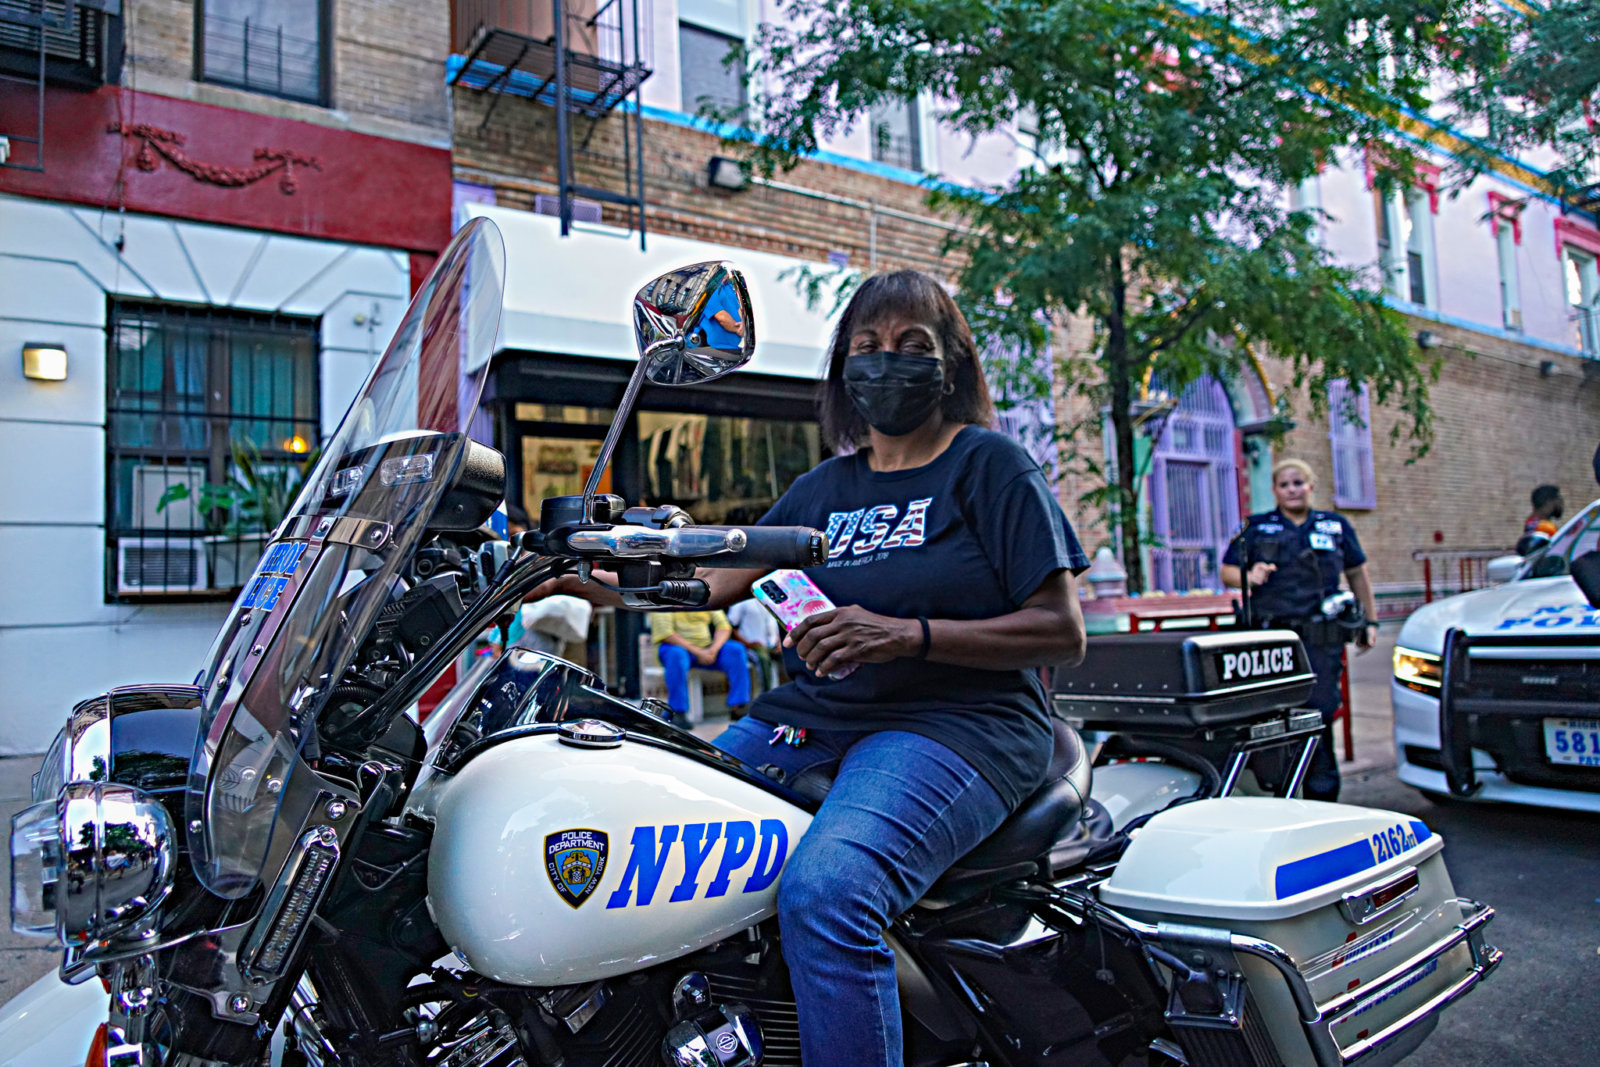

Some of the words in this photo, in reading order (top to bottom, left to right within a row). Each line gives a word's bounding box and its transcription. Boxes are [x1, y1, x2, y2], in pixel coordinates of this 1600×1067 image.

[825, 496, 933, 558] USA
[1223, 646, 1294, 680] POLICE
[1555, 730, 1600, 754] 581
[548, 839, 605, 855] DEPARTMENT
[561, 831, 593, 841] POLICE
[1372, 823, 1410, 864] 2162
[548, 862, 560, 881] CITY
[556, 882, 567, 893] OF
[585, 877, 598, 894] NEW
[595, 856, 606, 876] YORK
[606, 819, 789, 909] NYPD
